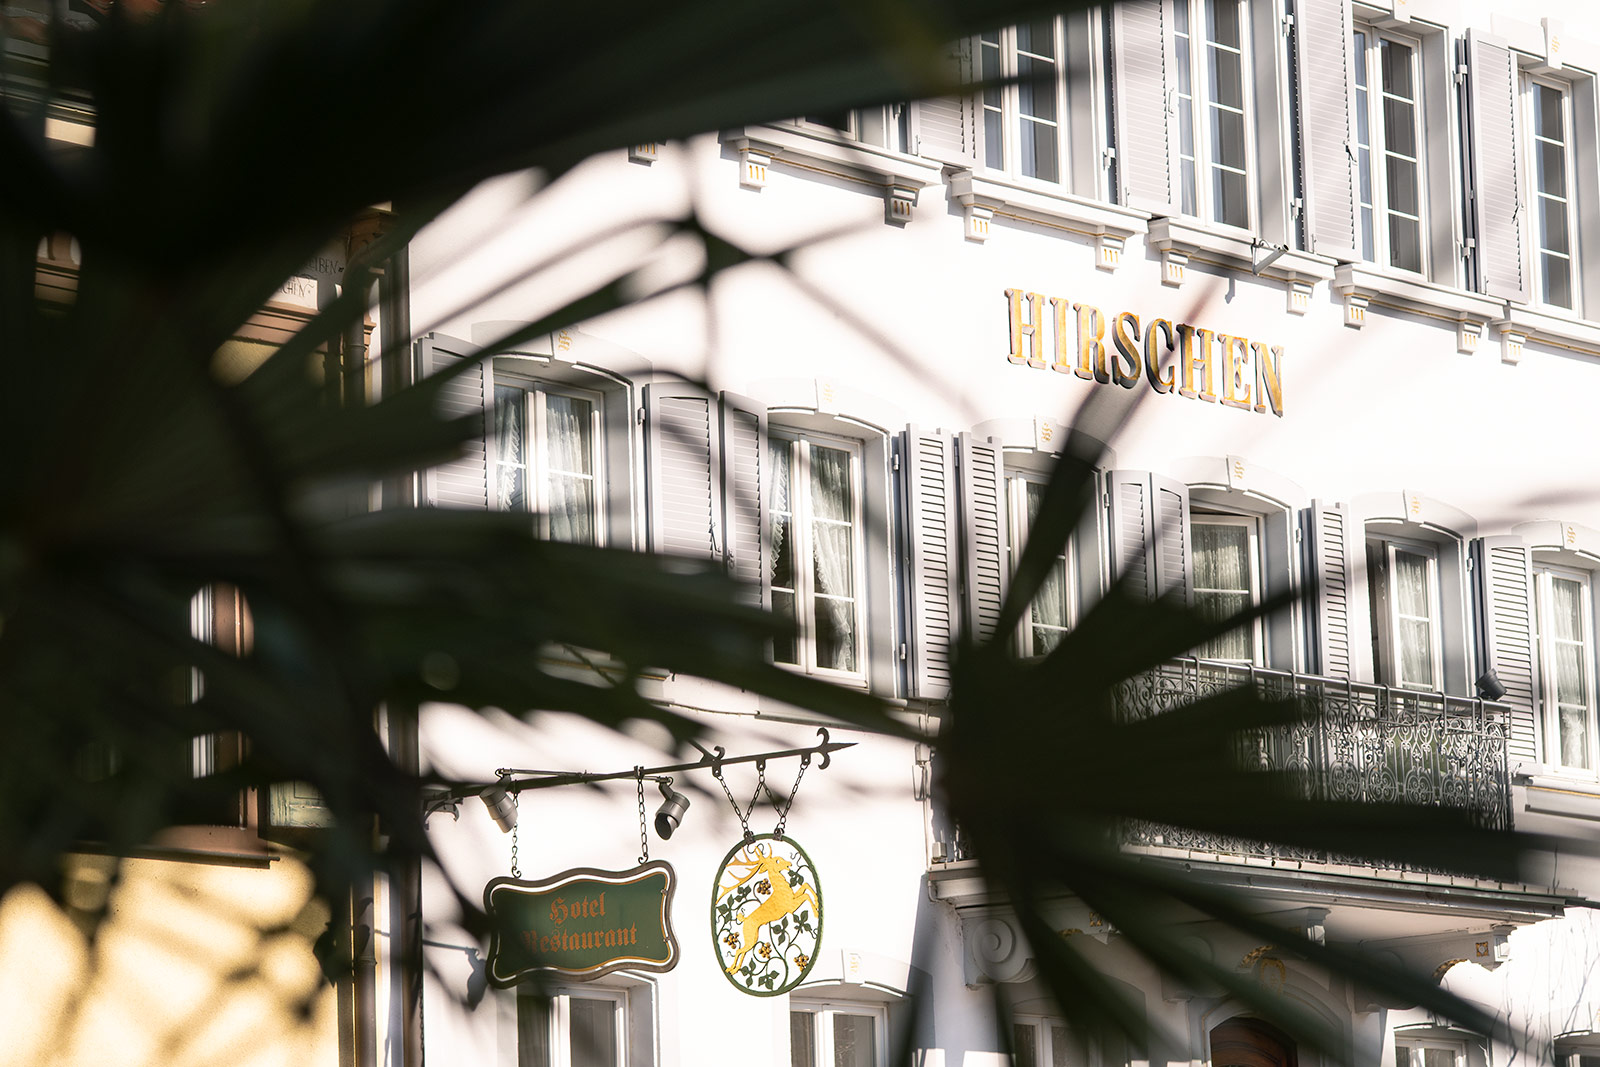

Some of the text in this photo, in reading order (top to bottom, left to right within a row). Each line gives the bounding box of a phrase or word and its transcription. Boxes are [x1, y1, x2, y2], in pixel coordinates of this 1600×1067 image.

[1004, 287, 1285, 418] HIRSCHEN
[549, 891, 606, 928] Hotel
[520, 922, 638, 954] Restaurant
